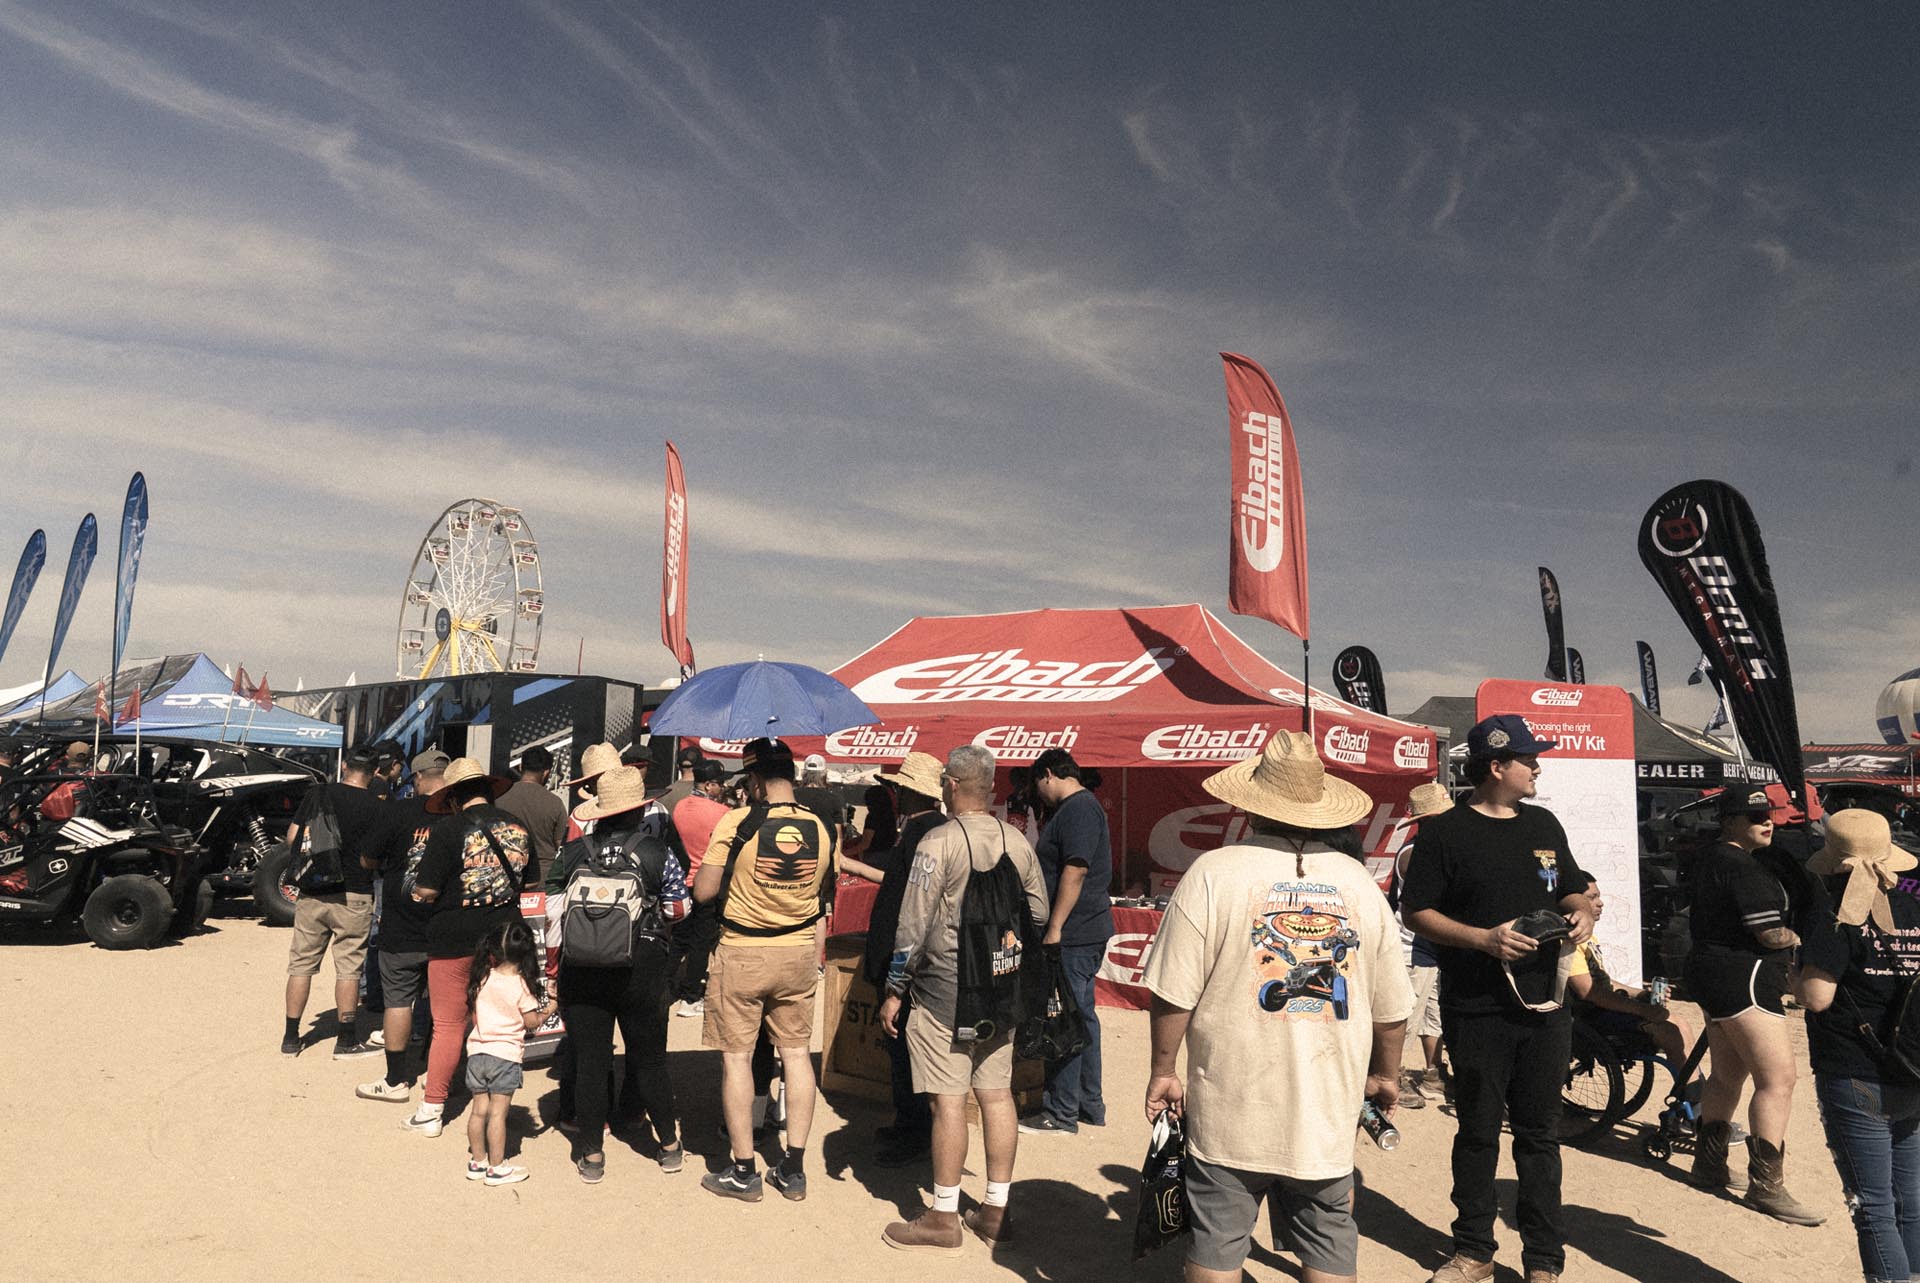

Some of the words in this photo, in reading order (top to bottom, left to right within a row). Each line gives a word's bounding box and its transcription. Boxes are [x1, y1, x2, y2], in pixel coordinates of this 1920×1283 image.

[1241, 411, 1282, 572] Eibach
[851, 648, 1174, 703] Eibach
[1531, 688, 1583, 706] Eibach
[296, 728, 330, 739] DRT
[1562, 723, 1574, 731] the
[1575, 722, 1591, 734] right
[825, 726, 918, 757] Eibach
[971, 725, 1080, 760] Eibach
[1141, 723, 1268, 760] Eibach
[1324, 726, 1370, 765] Eibach
[1394, 736, 1429, 769] Eibach
[1586, 736, 1606, 750] Kit
[1638, 764, 1705, 778] EALER
[1273, 882, 1337, 895] GLAMIS
[1288, 1000, 1324, 1012] 2025
